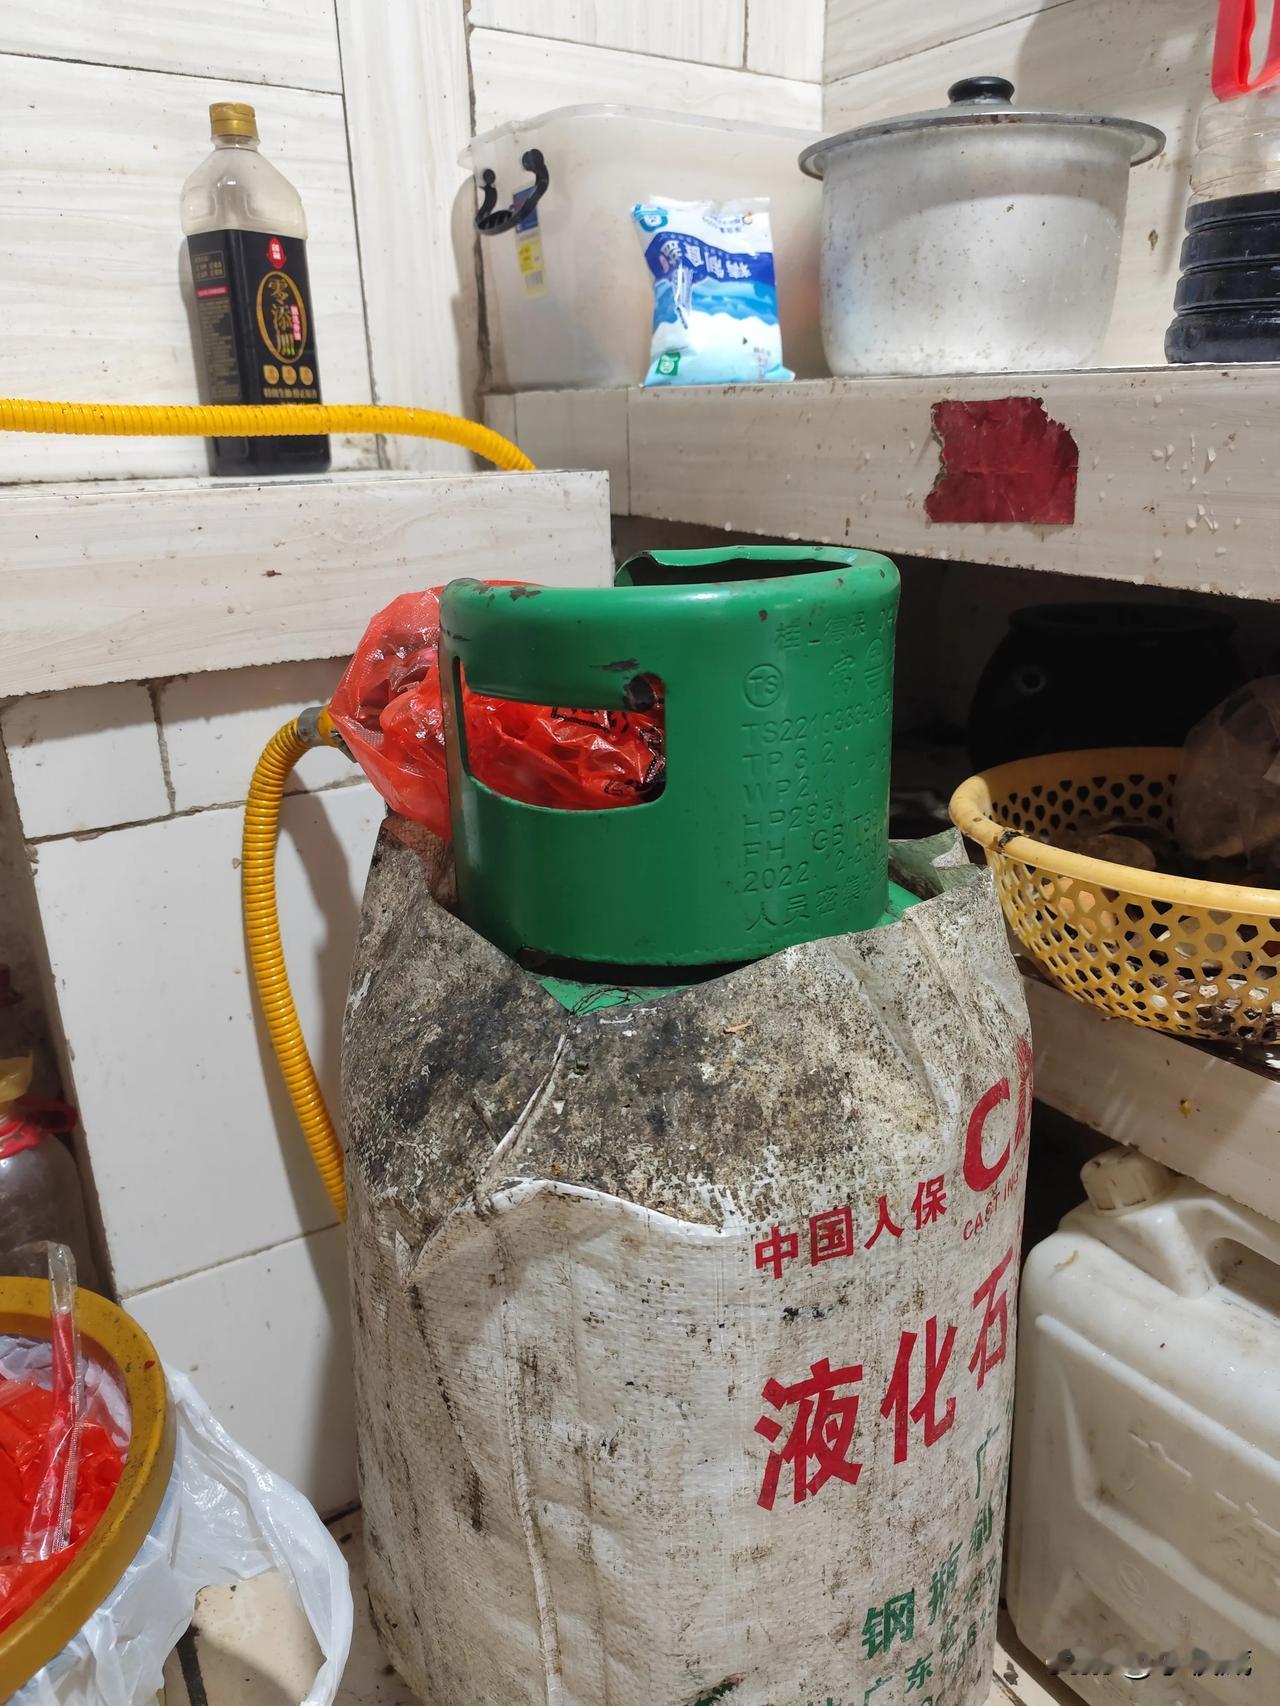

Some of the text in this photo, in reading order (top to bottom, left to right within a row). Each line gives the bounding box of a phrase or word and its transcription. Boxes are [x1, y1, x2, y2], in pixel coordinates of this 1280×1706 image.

[748, 673, 778, 698] TS
[754, 1174, 948, 1280] 中国人保
[753, 1246, 1014, 1512] 液化石
